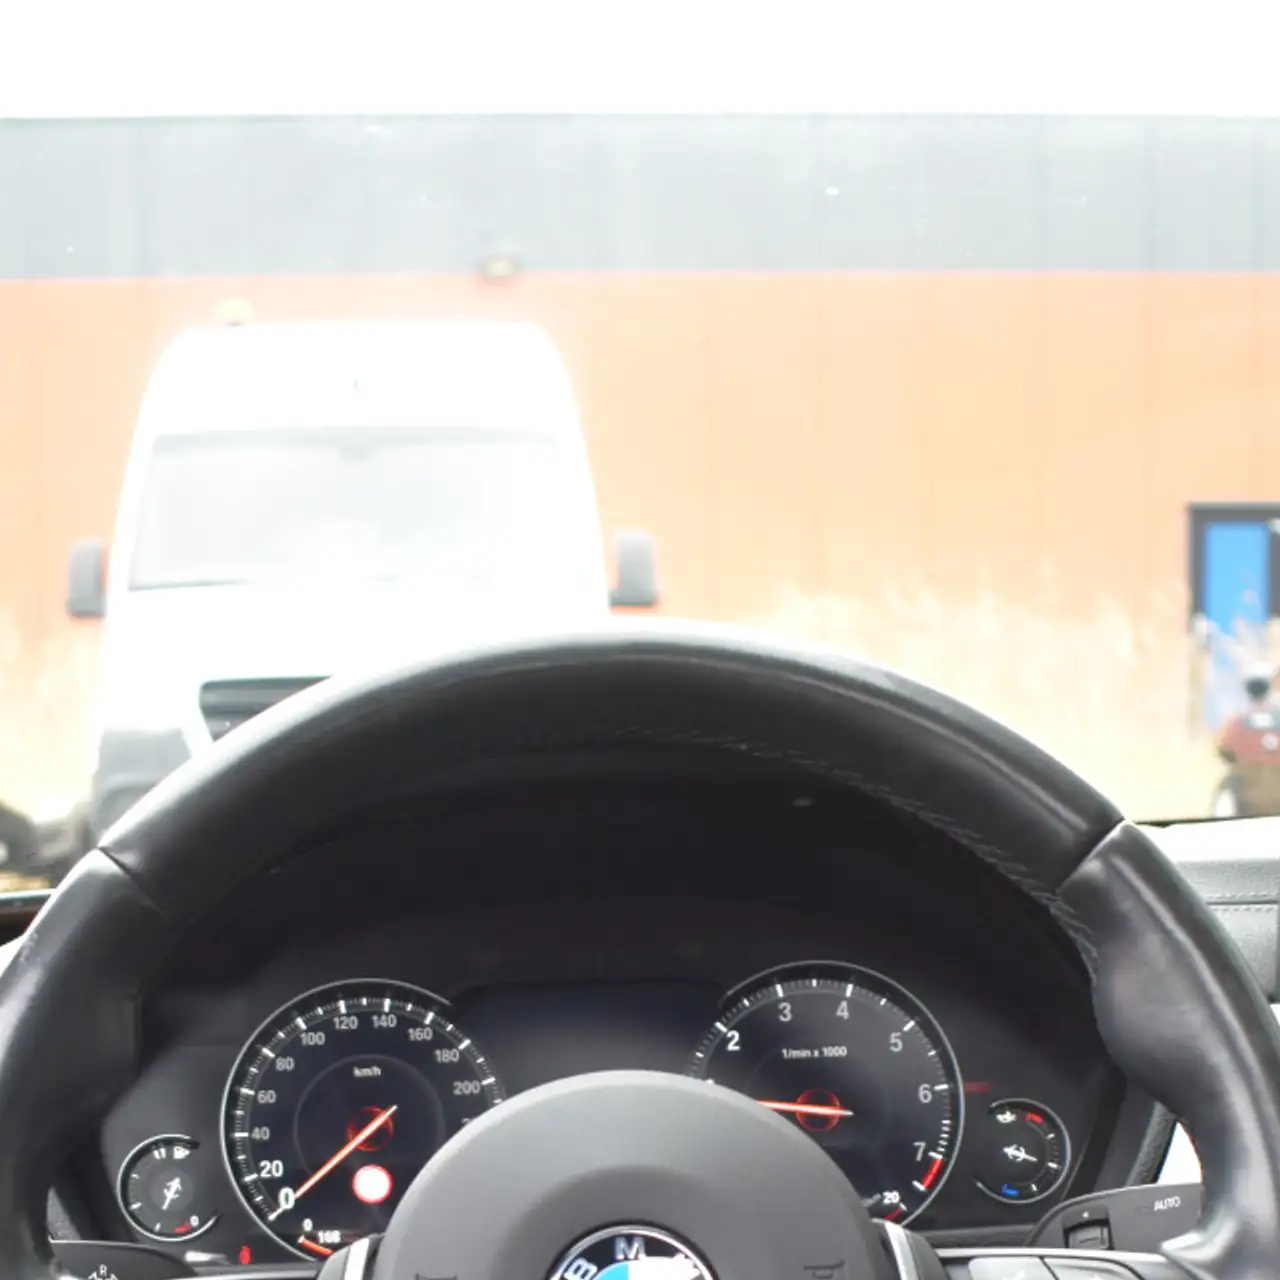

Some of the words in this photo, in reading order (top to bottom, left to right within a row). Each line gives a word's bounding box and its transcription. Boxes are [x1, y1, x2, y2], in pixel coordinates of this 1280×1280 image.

[778, 1003, 793, 1021] 3
[835, 1002, 850, 1020] 4
[333, 1016, 358, 1031] 120
[372, 1014, 397, 1029] 140
[300, 1031, 325, 1046] 100
[408, 1028, 433, 1042] 160
[726, 1031, 741, 1051] 2
[889, 1033, 903, 1053] 5
[435, 1049, 460, 1064] 180
[782, 1047, 811, 1060] 1/min
[821, 1046, 847, 1058] 1000
[276, 1057, 294, 1071] 80
[353, 1066, 381, 1078] km/h
[453, 1080, 481, 1095] 200
[918, 1084, 932, 1103] 6
[258, 1090, 277, 1104] 60
[251, 1127, 270, 1141] 40
[913, 1142, 927, 1161] 7
[259, 1160, 284, 1178] 20
[278, 1187, 295, 1209] 0
[1154, 1196, 1181, 1211] AUTO
[302, 1218, 313, 1231] 0
